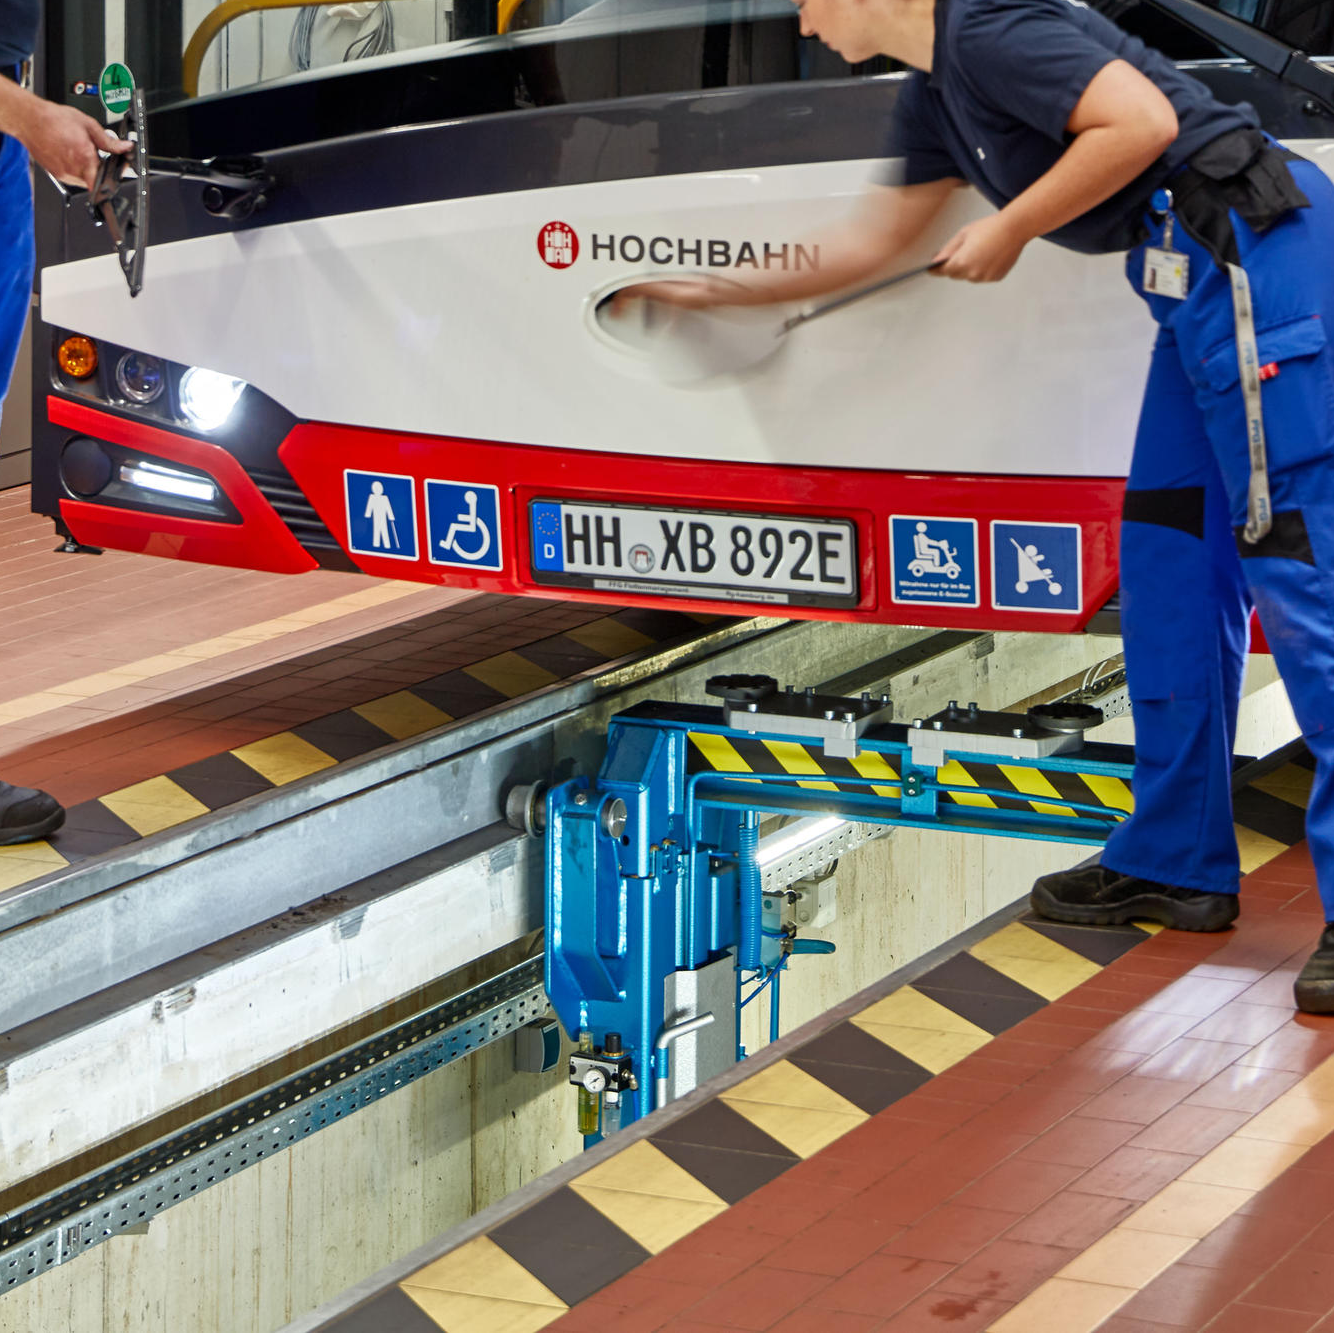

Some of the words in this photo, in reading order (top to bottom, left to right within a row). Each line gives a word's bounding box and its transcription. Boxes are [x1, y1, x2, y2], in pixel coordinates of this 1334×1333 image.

[592, 233, 820, 272] HOCHBAHN
[543, 543, 555, 560] D
[565, 513, 622, 568] HH
[660, 519, 716, 573] XB
[730, 525, 846, 585] 892E
